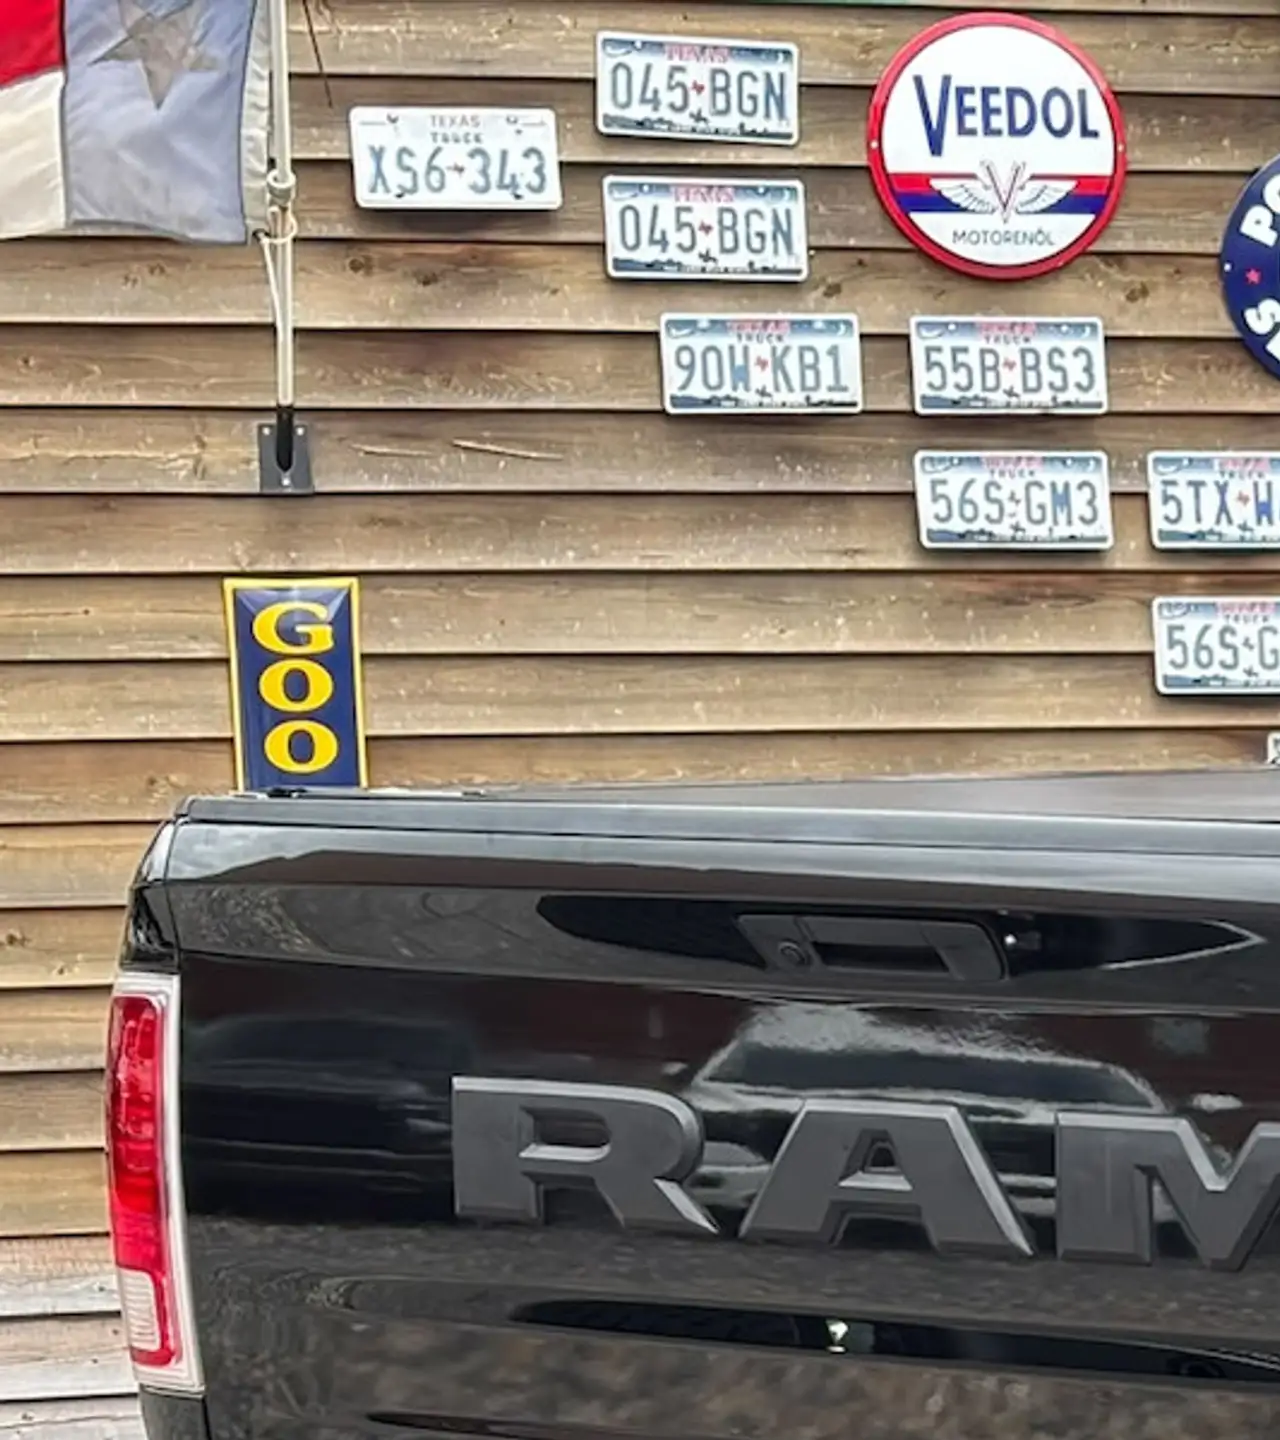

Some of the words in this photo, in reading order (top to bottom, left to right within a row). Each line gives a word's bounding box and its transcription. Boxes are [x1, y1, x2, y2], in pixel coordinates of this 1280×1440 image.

[430, 115, 481, 128] TEXAS
[430, 131, 484, 144] TRUCK
[913, 74, 1100, 157] VEEDOL
[674, 344, 751, 392] 90W
[930, 478, 1005, 525] 56S
[1166, 624, 1240, 670] 56S
[252, 601, 339, 773] GOO
